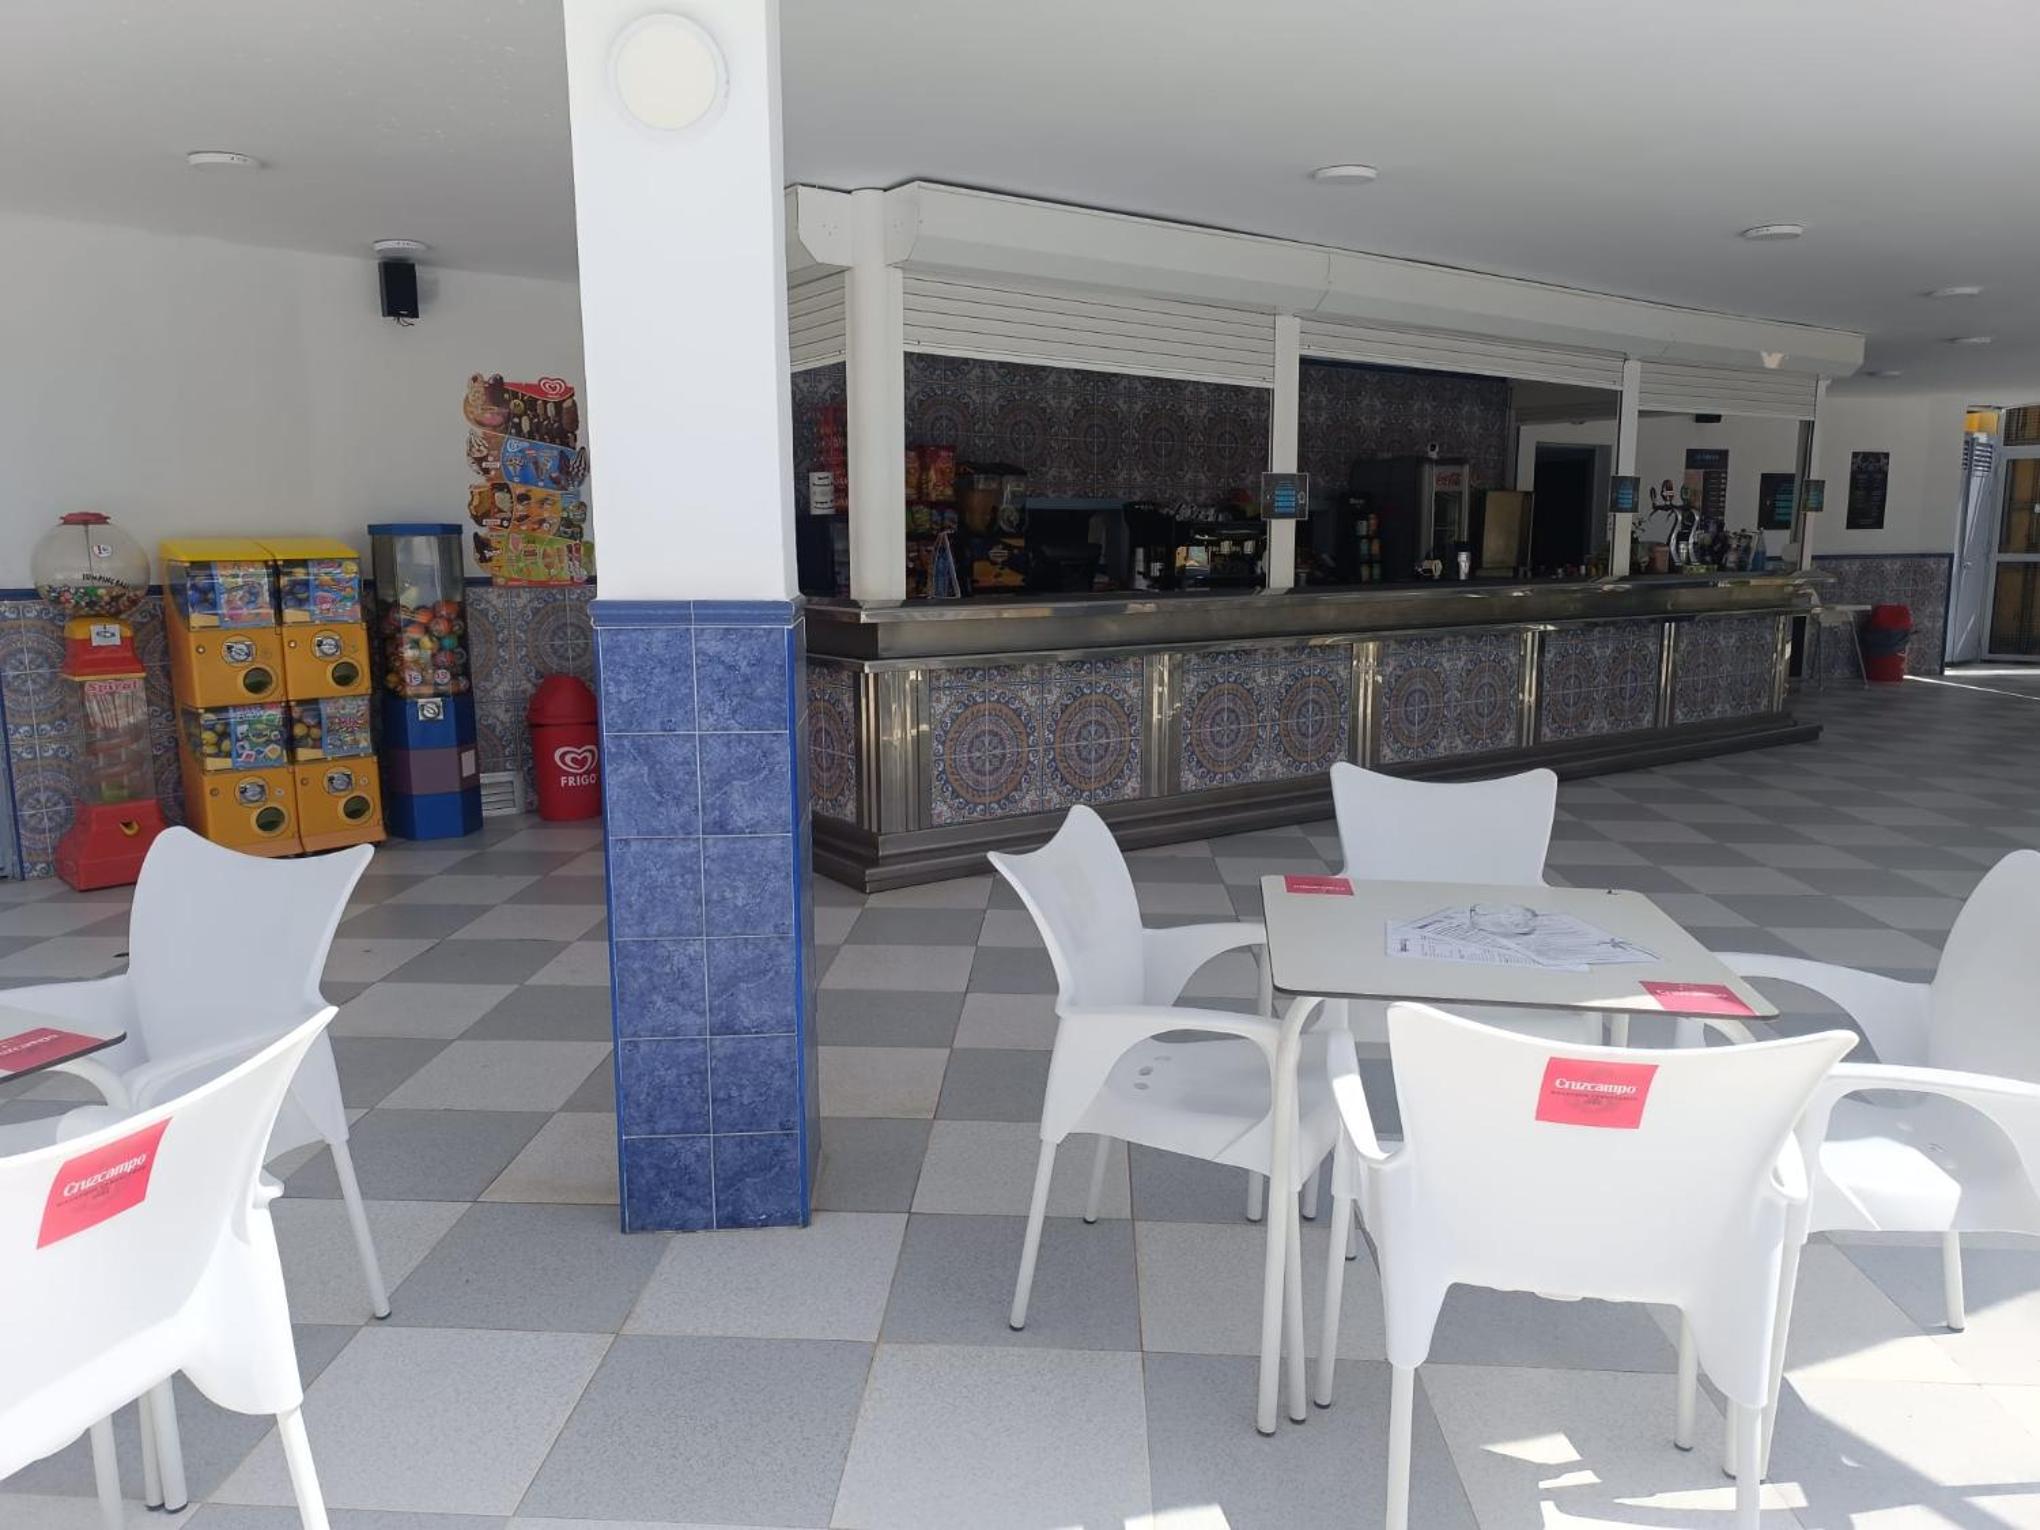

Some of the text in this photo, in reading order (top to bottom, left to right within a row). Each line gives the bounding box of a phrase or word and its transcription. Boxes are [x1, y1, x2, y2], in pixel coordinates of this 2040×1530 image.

[560, 773, 597, 787] FRIGO
[1555, 1078, 1638, 1095] Cruzcampo
[63, 1152, 147, 1197] Cruzcampo
